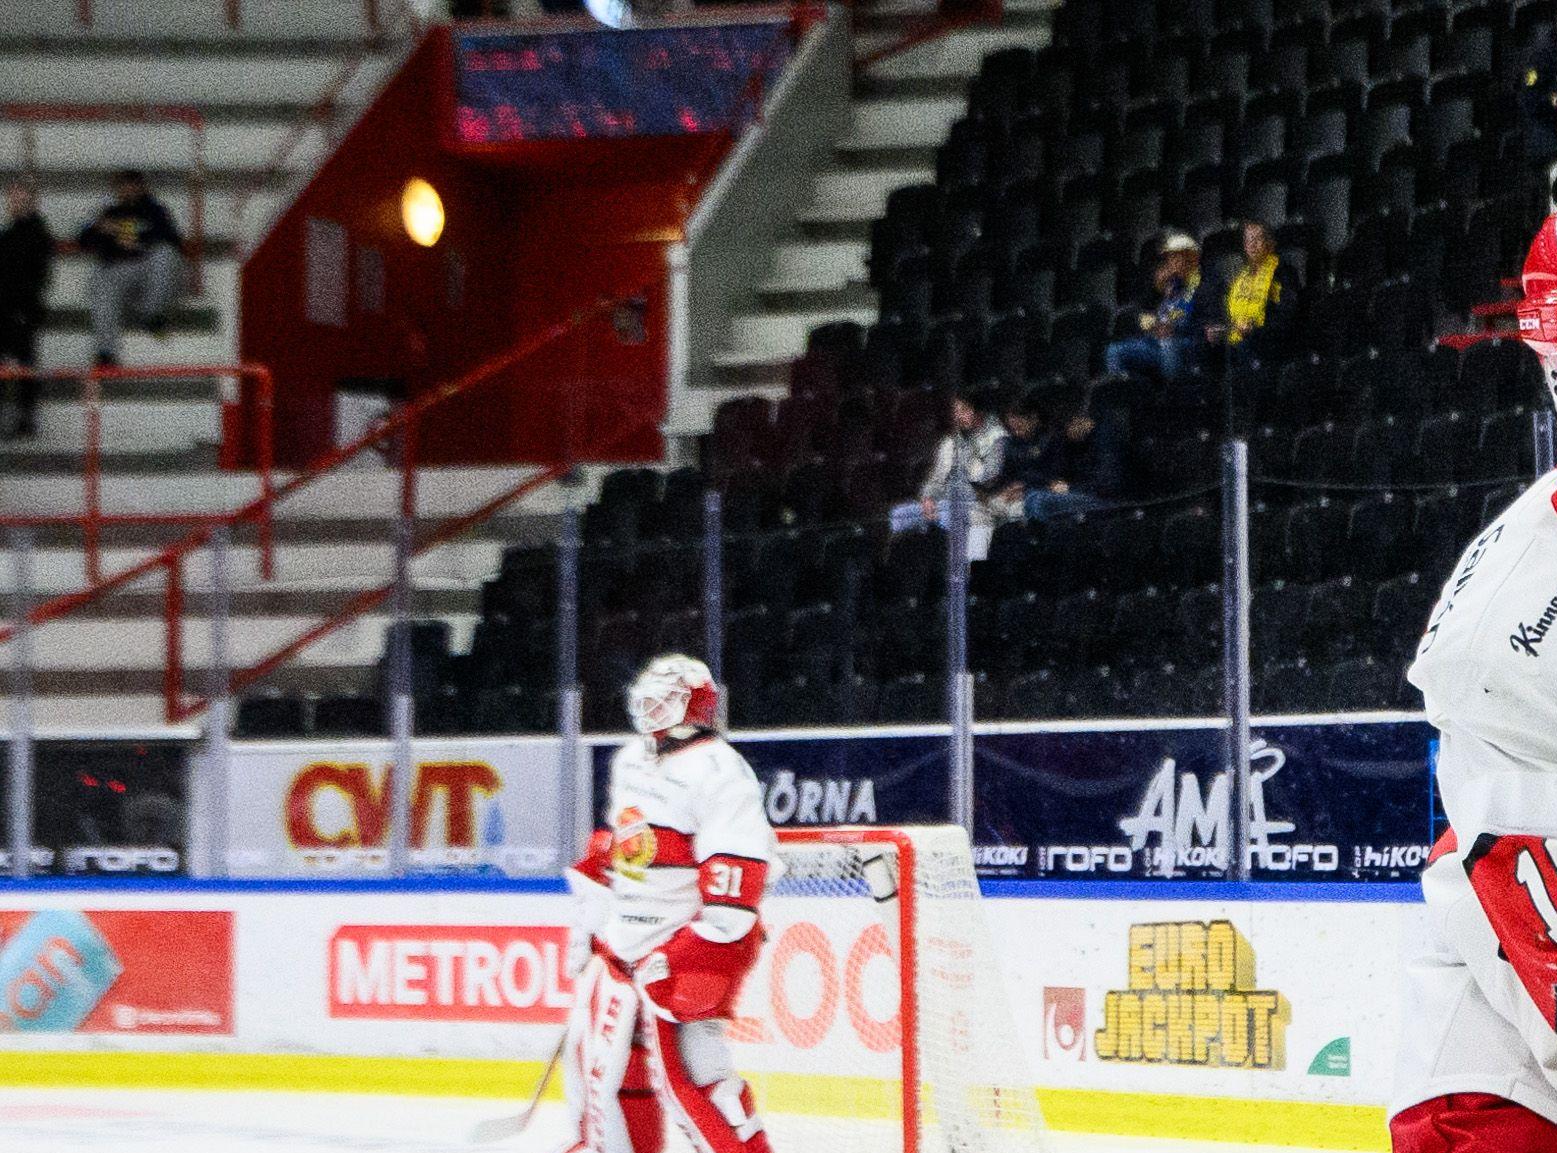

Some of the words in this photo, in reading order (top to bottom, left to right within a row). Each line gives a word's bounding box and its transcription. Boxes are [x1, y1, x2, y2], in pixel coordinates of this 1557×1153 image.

[708, 862, 743, 898] 31
[1128, 920, 1237, 990] EURO
[1094, 989, 1279, 1068] JACKPOT
